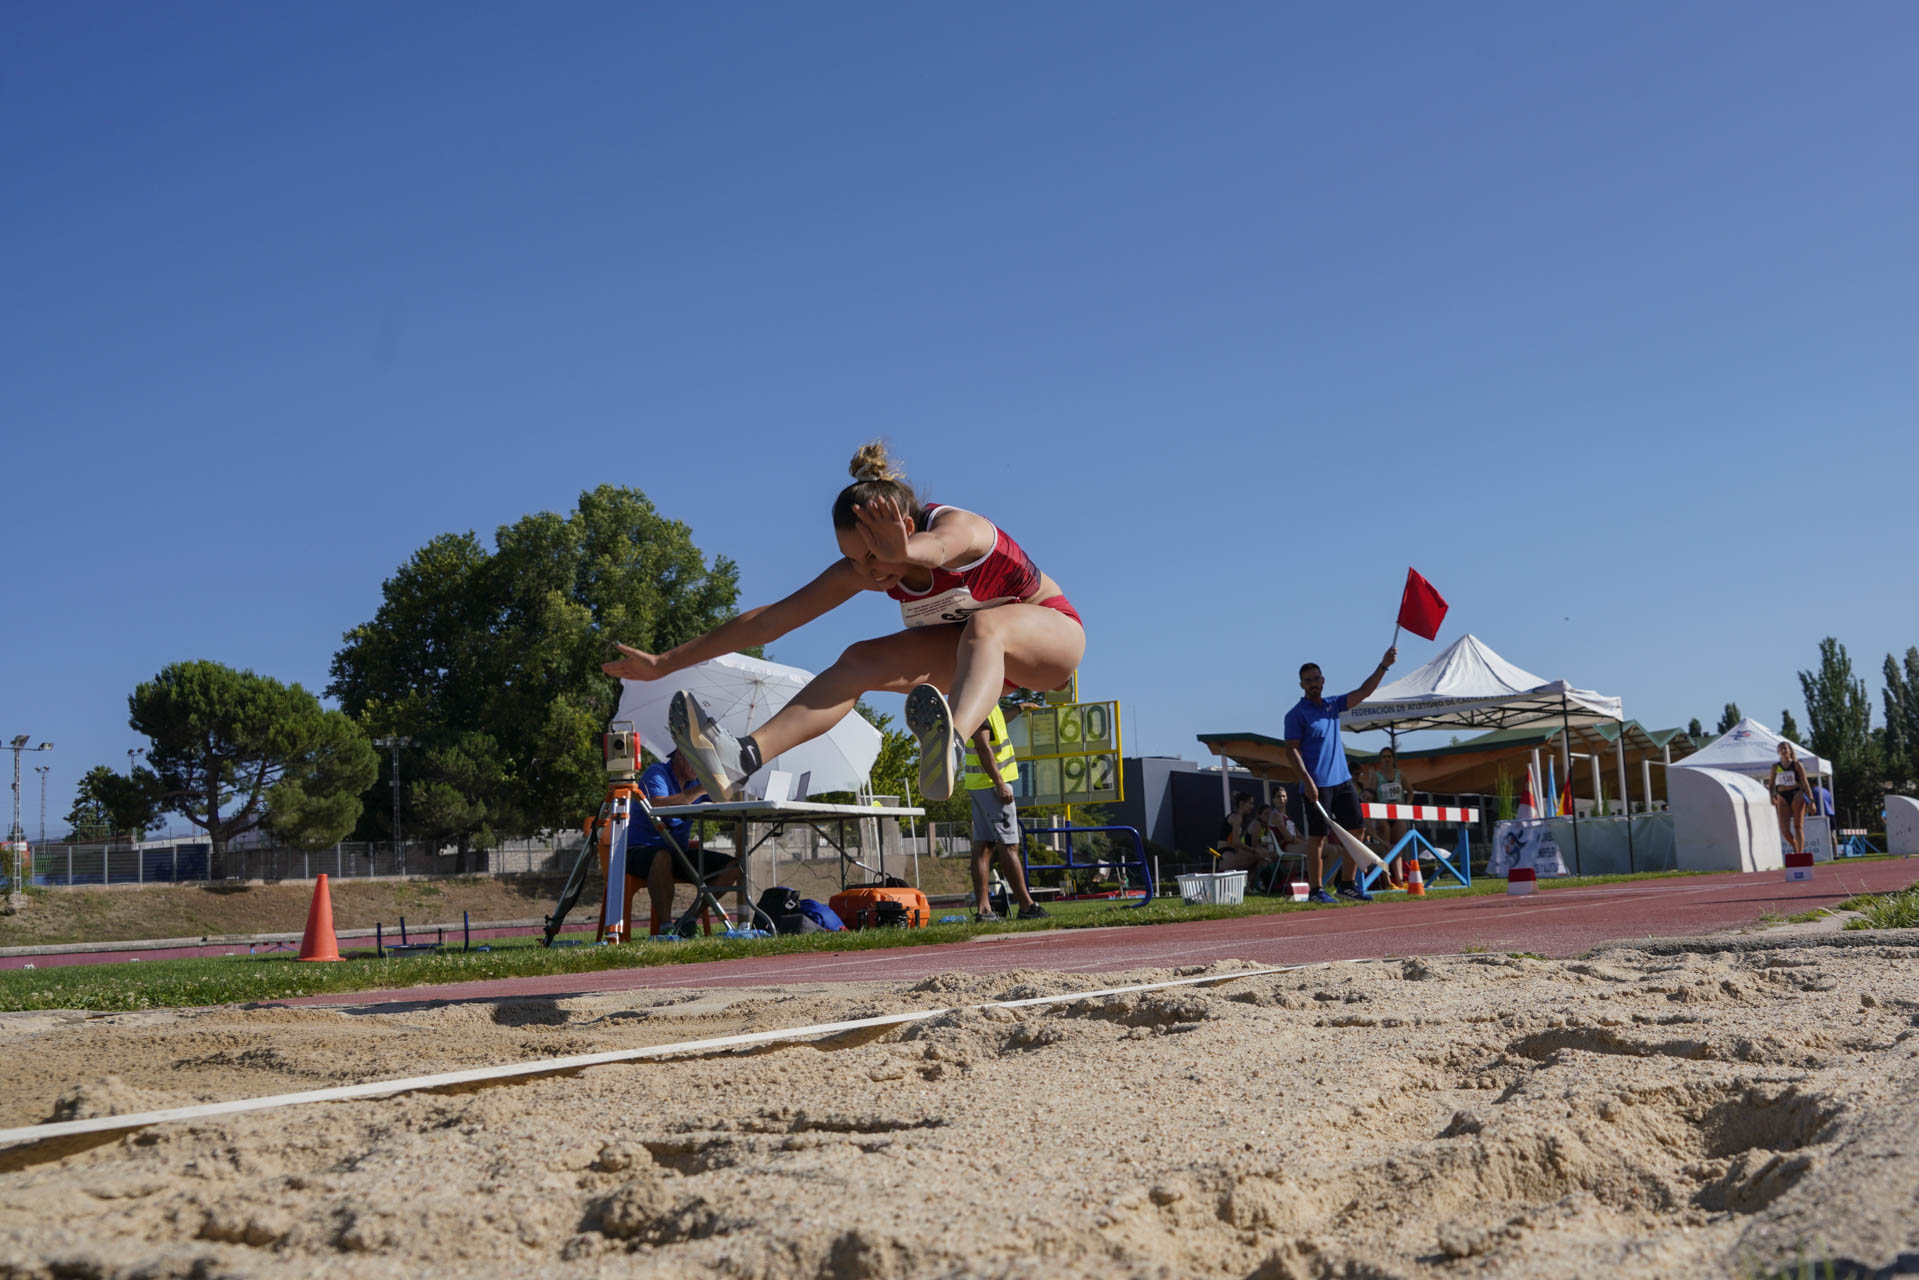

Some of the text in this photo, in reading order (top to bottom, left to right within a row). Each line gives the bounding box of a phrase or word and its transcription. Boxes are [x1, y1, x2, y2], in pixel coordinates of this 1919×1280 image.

[1060, 705, 1107, 742] 60
[1396, 703, 1407, 713] DE
[1407, 700, 1444, 711] ATLETISMO
[1065, 755, 1113, 792] 92
